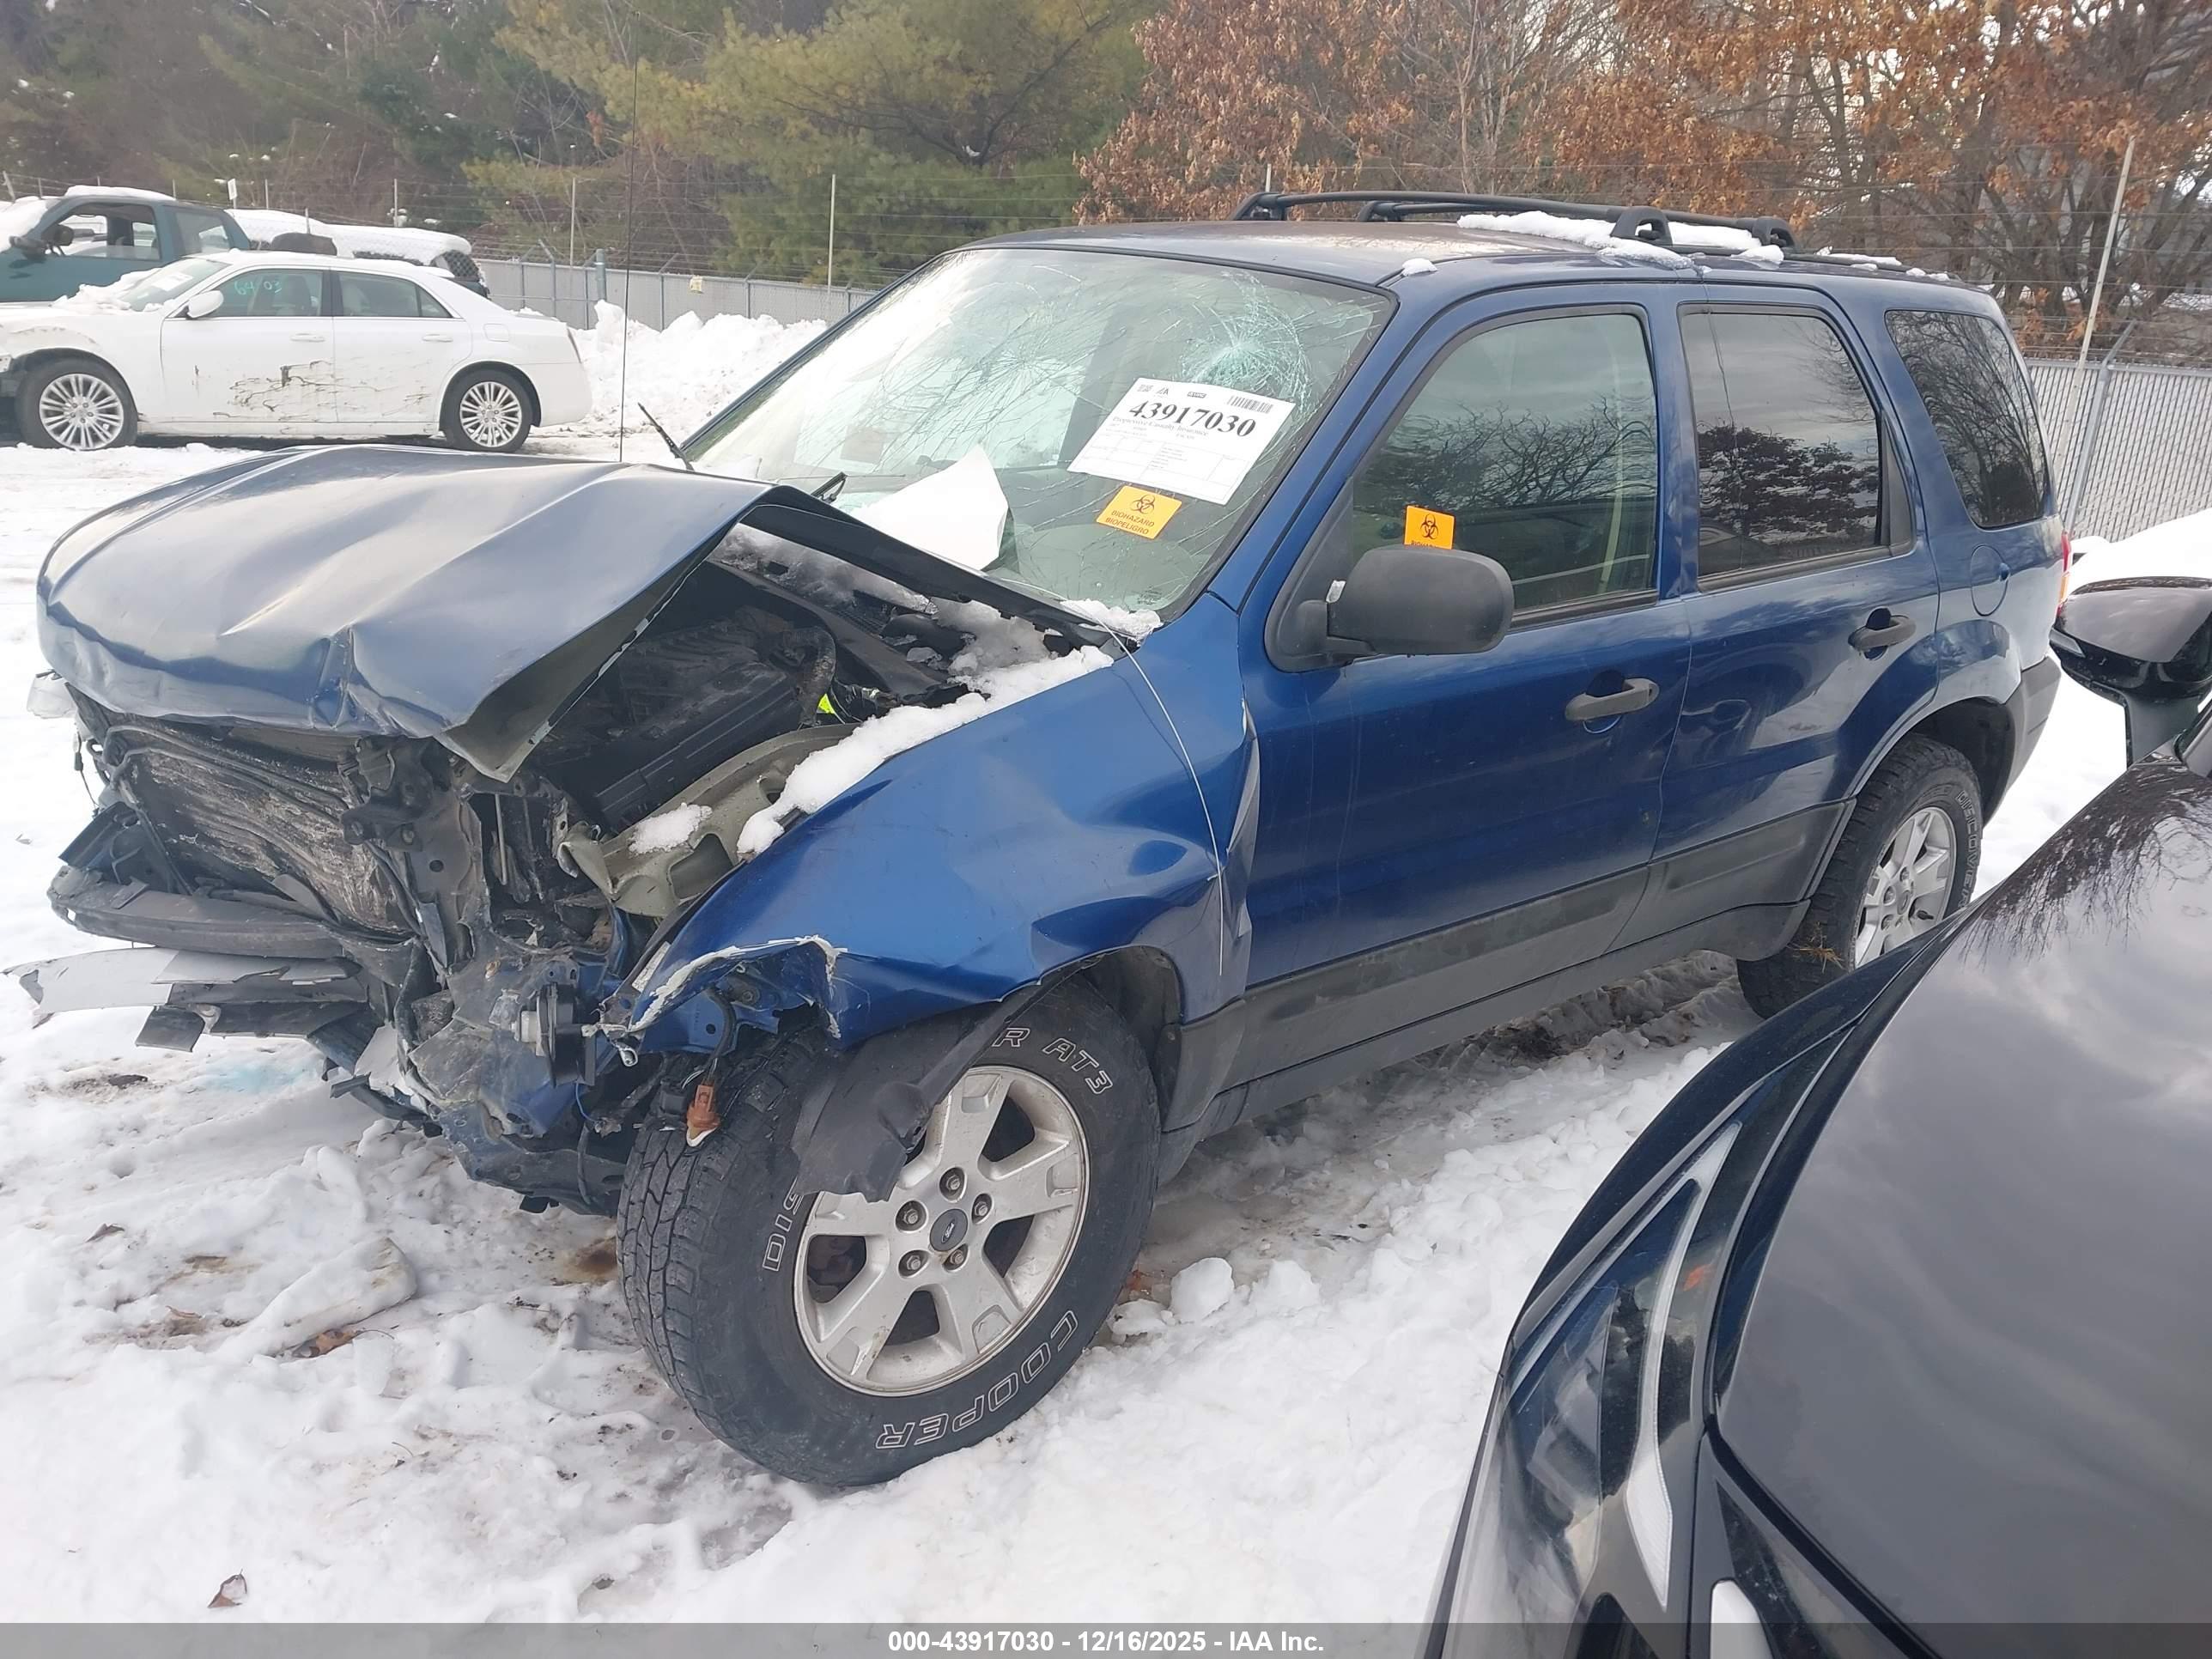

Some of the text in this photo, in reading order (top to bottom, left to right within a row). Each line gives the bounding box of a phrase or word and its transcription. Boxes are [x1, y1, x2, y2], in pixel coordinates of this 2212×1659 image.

[1129, 400, 1256, 437] 43917030
[1105, 517, 1149, 535] BIOPELIGRO
[1111, 510, 1155, 527] BIOHAZARD
[1042, 1037, 1114, 1094] AT3
[876, 1310, 1079, 1449] COOPER
